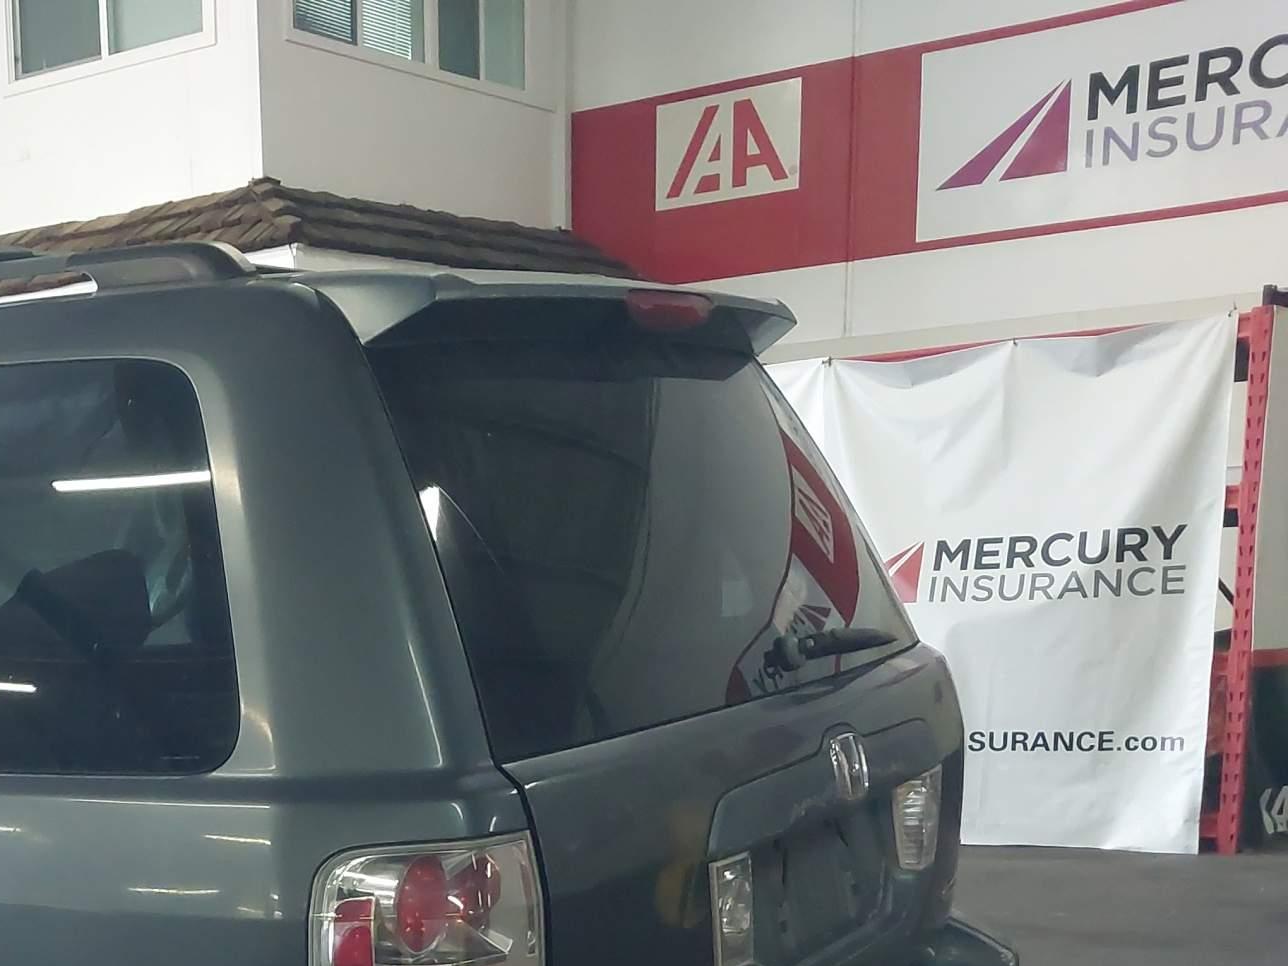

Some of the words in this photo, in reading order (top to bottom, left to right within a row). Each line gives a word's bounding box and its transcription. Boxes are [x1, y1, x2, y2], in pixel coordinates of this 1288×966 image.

[1085, 100, 1288, 168] INSUR
[933, 524, 1187, 571] MERCURY
[928, 565, 1186, 602] INSURANCE
[967, 731, 1185, 752] SURANCE.com
